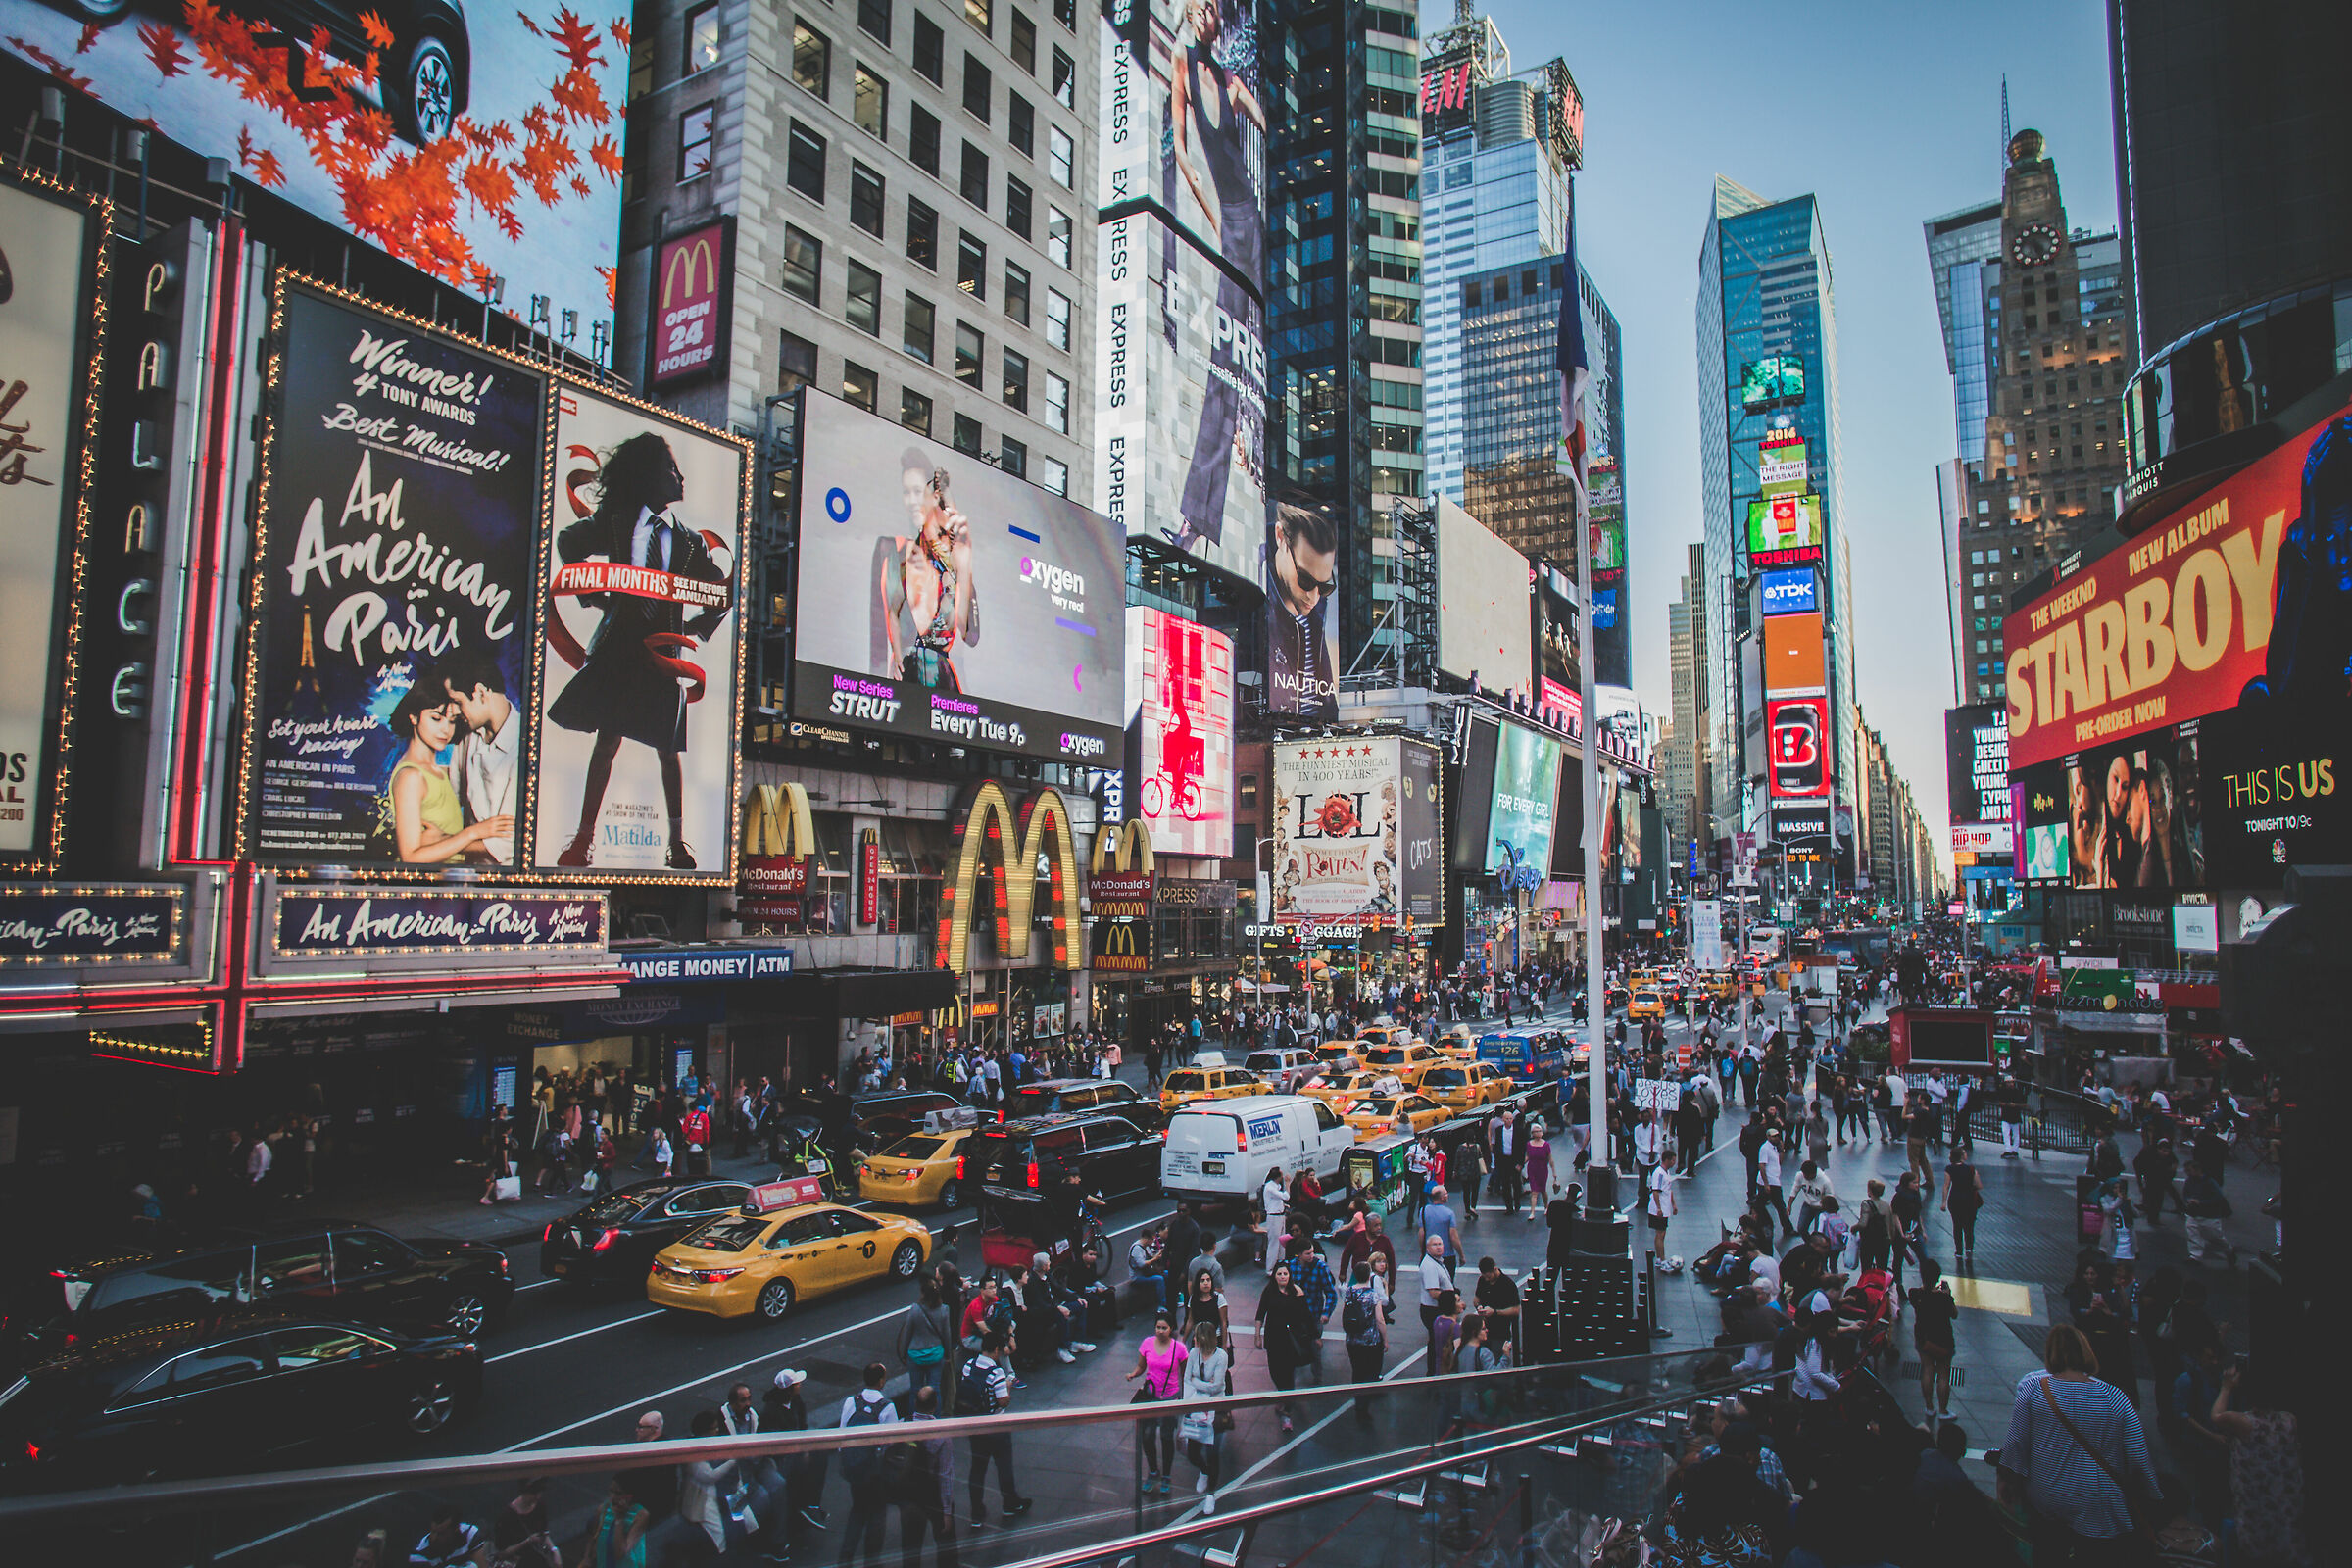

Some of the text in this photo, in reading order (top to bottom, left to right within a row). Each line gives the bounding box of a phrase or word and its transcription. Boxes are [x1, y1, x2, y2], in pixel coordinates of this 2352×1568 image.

[1114, 39, 1130, 144] EXPRESS
[665, 300, 710, 326] OPEN
[668, 319, 704, 353] 24
[658, 345, 713, 374] HOURS
[1110, 305, 1126, 408] EXPRESS
[350, 329, 493, 405] Winner!
[353, 372, 476, 425] 4 TONY AWARDS
[321, 403, 399, 441] Best
[403, 424, 510, 472] Musical!
[1760, 436, 1804, 449] TOSHIBA
[1767, 427, 1796, 441] 2016
[1761, 466, 1776, 474] THE
[1762, 471, 1803, 482] MESSAGE
[112, 262, 168, 716] PALACE
[340, 449, 405, 530] An
[2128, 498, 2230, 576] NEW ALBUM
[1751, 546, 1823, 566] TOSHIBA
[286, 497, 513, 640] American
[1020, 557, 1084, 595] oxygen
[407, 582, 429, 600] in
[561, 567, 669, 596] FINAL MONTHS
[672, 576, 727, 596] SEE IT BEFORE
[1776, 582, 1813, 600] TDK
[672, 588, 727, 607] JANUARY 1
[1051, 594, 1084, 613] very real
[2031, 575, 2097, 632] THE WEEKND
[324, 591, 460, 666] Paris
[2006, 509, 2285, 737] STARBOY
[833, 674, 894, 699] New Series
[1274, 671, 1338, 697] NAUTICA
[829, 691, 901, 723] STRUT
[931, 694, 978, 714] Premieres
[930, 710, 1027, 747] Every Tue 9p
[2075, 696, 2166, 743] PRE-ORDER NOW
[268, 714, 379, 746] Set your heart
[1973, 726, 2008, 744] YOUNG
[298, 736, 365, 759] racing
[1060, 732, 1104, 757] oxygen
[1975, 743, 2009, 760] DESIIG
[265, 760, 356, 774] AN AMERICAN IN PARIS
[1283, 757, 1390, 771] THE FUNNIEST MUSICAL
[1973, 759, 2002, 774] GUCCI
[1298, 770, 1334, 782] IN 400
[1972, 774, 2008, 790] YOUNG
[2223, 758, 2335, 808] THIS IS US
[1294, 791, 1380, 840] LOL
[1497, 793, 1549, 819] FOR EVERY GIRL
[1980, 805, 2000, 820] AND
[1778, 822, 1825, 833] MASSIVE
[2245, 814, 2313, 833] TONIGHT 10/9c
[602, 824, 661, 847] Matilda
[1952, 833, 1991, 846] HIP HOP
[1410, 838, 1432, 870] CATS
[2273, 855, 2286, 863] NBC
[739, 868, 804, 881] McDonald's
[1091, 879, 1150, 890] McDonald's
[2181, 893, 2208, 904] INVICTA
[770, 907, 797, 916] HOURS
[2113, 904, 2165, 924] Brookstone
[56, 908, 121, 947] Paris
[300, 899, 585, 946] An American in Paris A New
[548, 920, 588, 942] Musical
[1245, 925, 1285, 938] GIFTS
[684, 956, 790, 976] MONEY ATM
[1144, 984, 1165, 994] EXPRESS
[623, 997, 681, 1010] EXCHANGE
[514, 1011, 550, 1025] MONEY
[507, 1024, 562, 1040] EXCHANGE
[1501, 1046, 1520, 1056] $26
[1638, 1098, 1670, 1109] YOU
[1250, 1119, 1281, 1140] MERLIN
[1802, 1184, 1821, 1196] GAP
